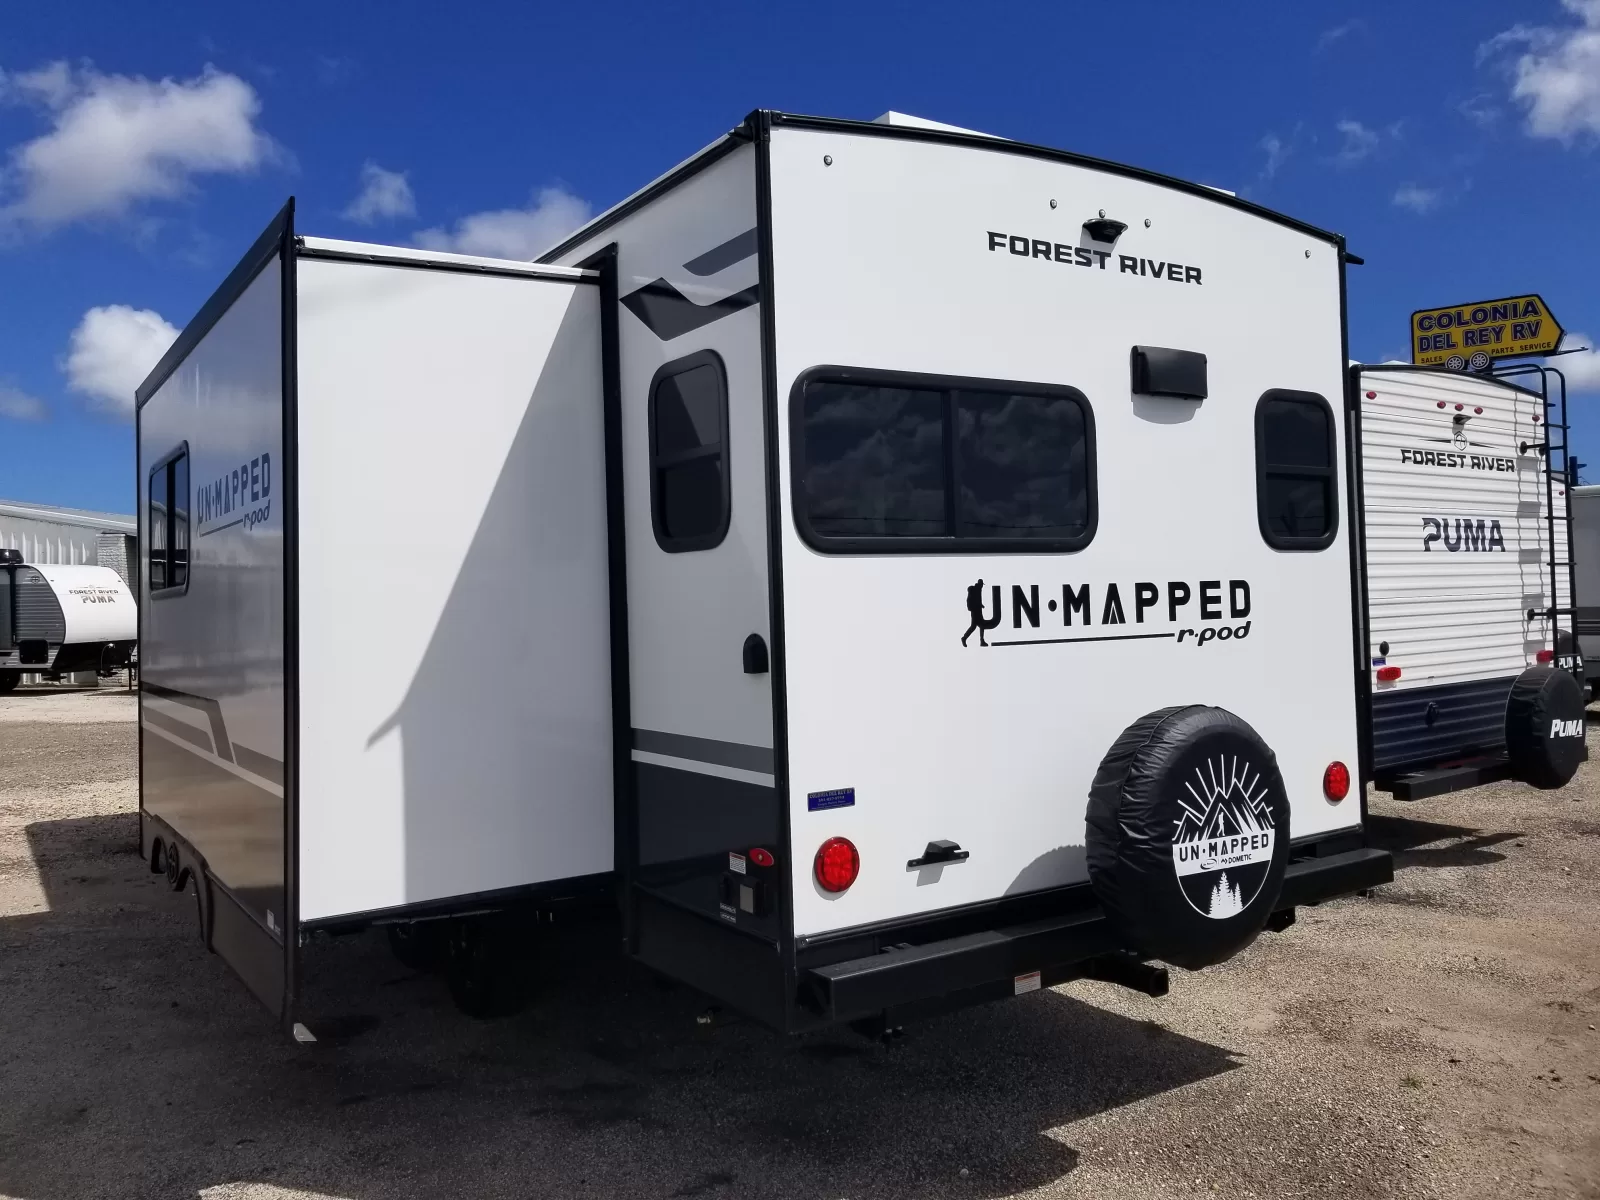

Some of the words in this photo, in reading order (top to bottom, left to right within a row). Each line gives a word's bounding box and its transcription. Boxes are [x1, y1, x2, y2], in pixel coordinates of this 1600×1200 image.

[986, 231, 1111, 269] FOREST
[1119, 254, 1203, 285] RIVER
[1417, 299, 1542, 332] COLONIA
[1417, 332, 1458, 353] DEL
[1463, 324, 1506, 348] REY
[1511, 320, 1542, 341] RV
[1421, 355, 1443, 364] SALES
[1491, 346, 1514, 355] PARTS
[1519, 341, 1552, 352] SERVICE
[1400, 449, 1466, 469] FOREST
[1470, 455, 1516, 472] RIVER
[1422, 517, 1506, 552] PUMA
[81, 595, 116, 603] PUMA
[1550, 719, 1583, 739] PUMA
[1228, 853, 1252, 864] DOMETIC
